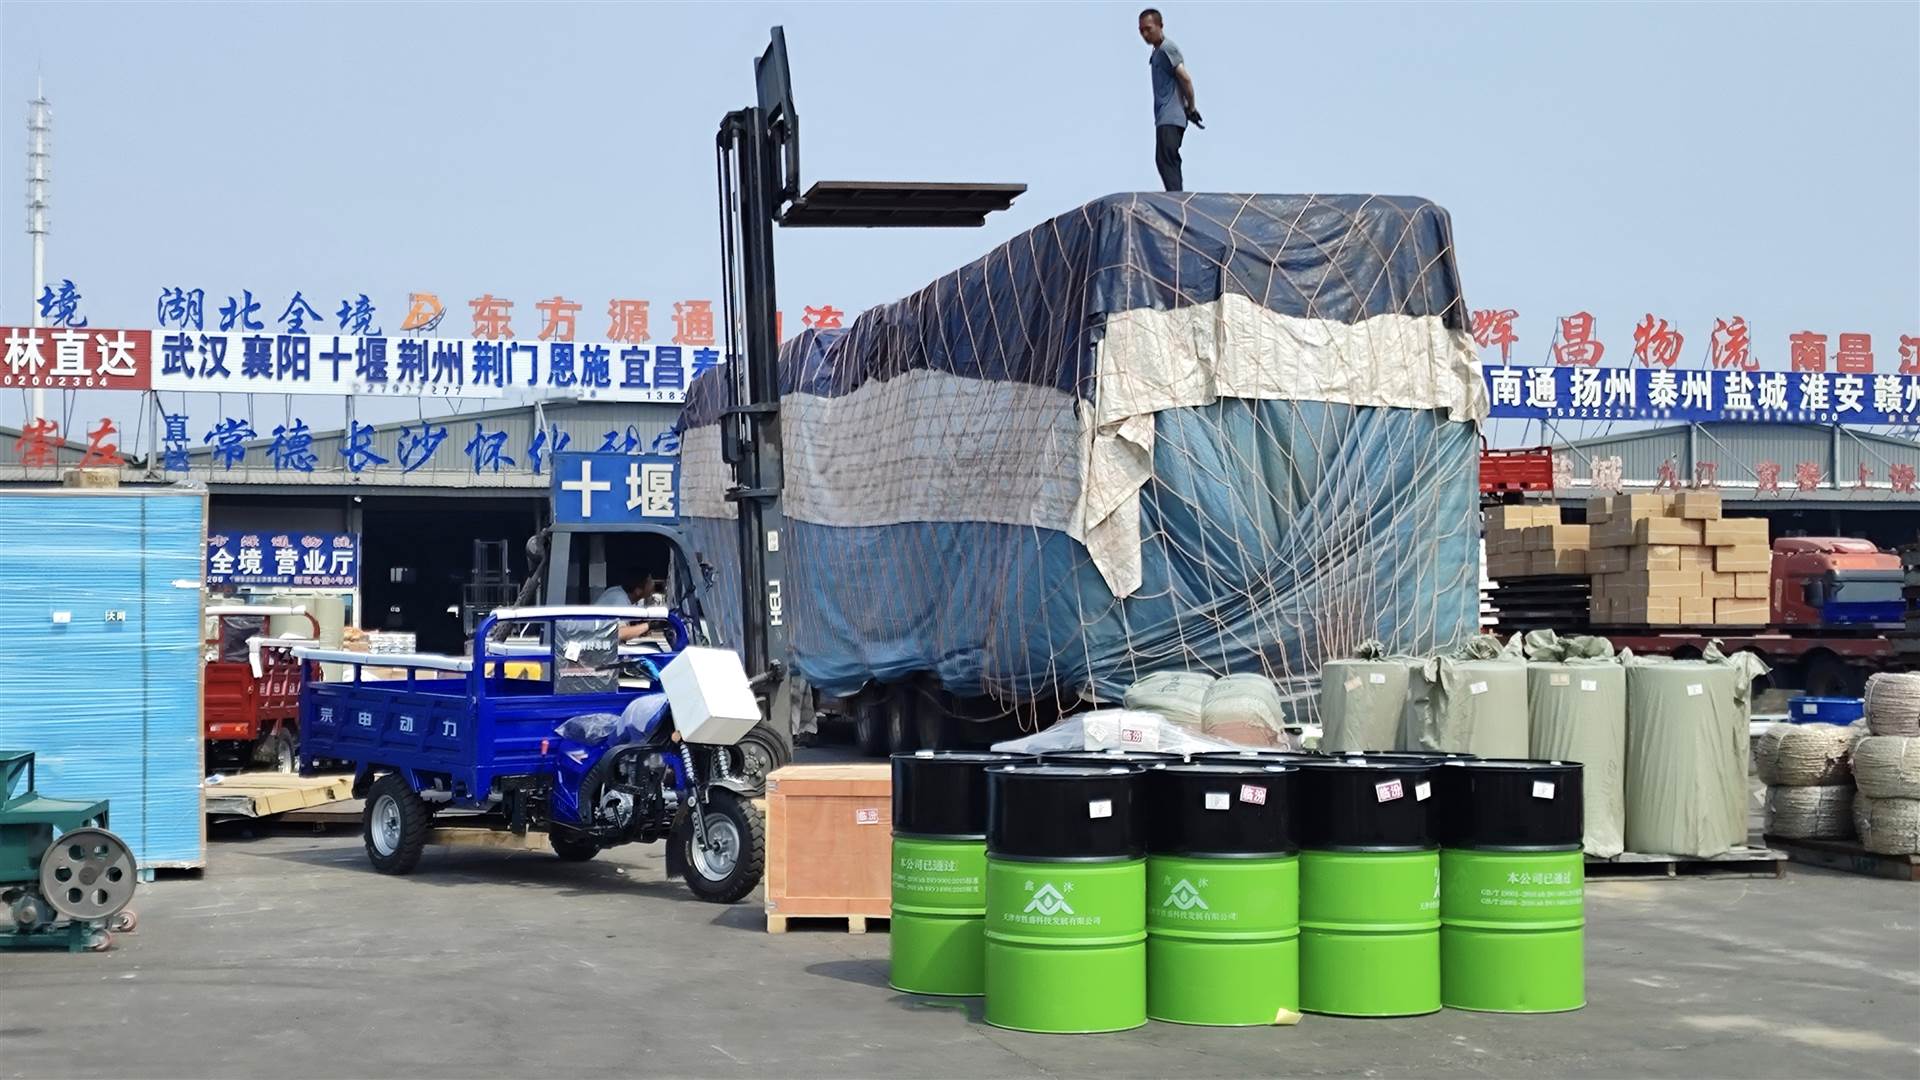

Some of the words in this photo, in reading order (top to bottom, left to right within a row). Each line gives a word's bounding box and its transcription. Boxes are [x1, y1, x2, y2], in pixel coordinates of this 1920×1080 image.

[37, 280, 87, 327] 境
[157, 287, 382, 337] 湖北全境
[4, 328, 137, 378] 林直达
[161, 333, 232, 380] 武汉
[242, 335, 309, 383] 襄阳
[319, 337, 388, 384] 十堰
[397, 339, 463, 386] 荆州
[472, 341, 538, 388] 荆门
[547, 343, 611, 388] 恩施
[620, 346, 684, 390] 宜昌
[3, 375, 108, 388] 02002364
[1490, 366, 1557, 408] 南通
[1570, 367, 1636, 408] 扬州
[1648, 370, 1712, 411] 泰州
[1724, 371, 1788, 412] 盐城
[1799, 374, 1865, 414] 淮安
[562, 460, 675, 517] 十堰
[210, 548, 263, 575] 全境
[275, 548, 354, 575] 营业厅
